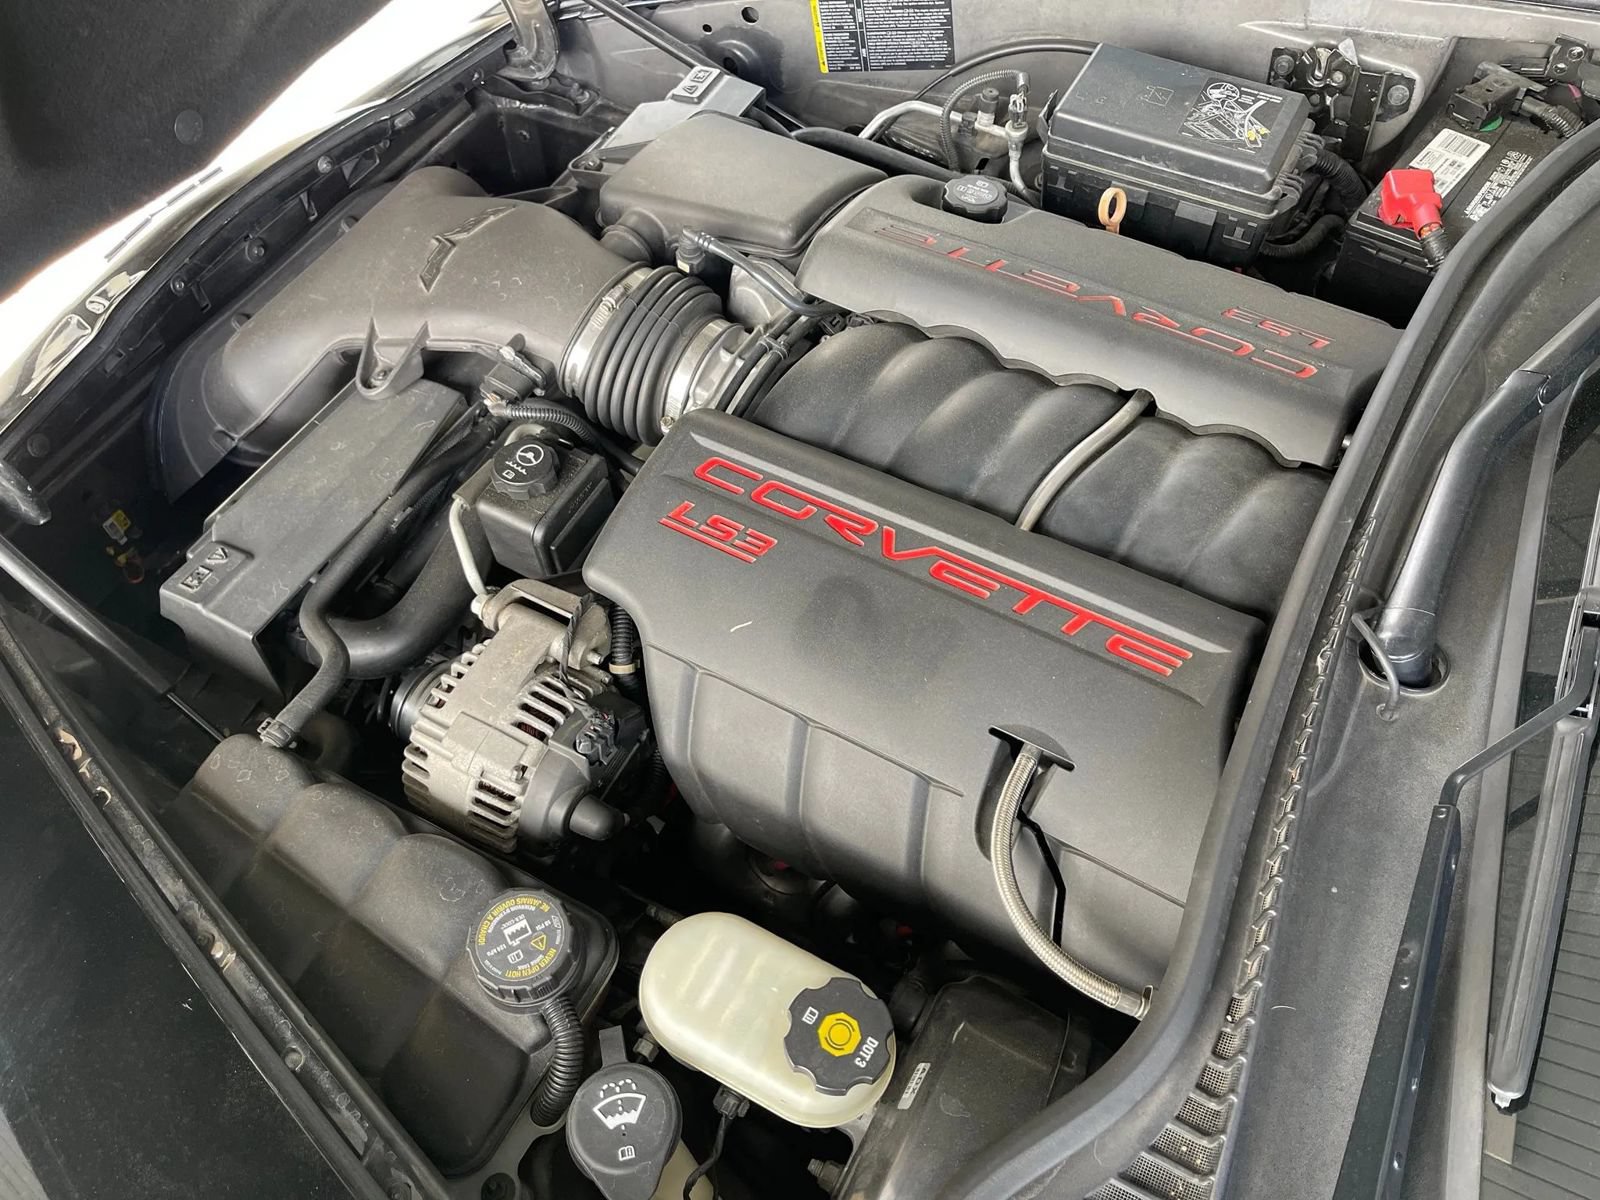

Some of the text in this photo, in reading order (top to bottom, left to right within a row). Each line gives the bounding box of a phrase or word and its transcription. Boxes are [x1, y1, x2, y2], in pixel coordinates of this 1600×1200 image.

[873, 223, 1319, 380] CORVETTE
[1221, 306, 1331, 350] LS3
[666, 500, 778, 558] LS3
[694, 456, 1194, 677] CORVETTE
[491, 898, 515, 917] OUVRIR
[516, 896, 542, 907] JAMAIS
[539, 947, 557, 968] NEVER
[505, 969, 521, 978] HOT!
[522, 963, 540, 977] OPEN
